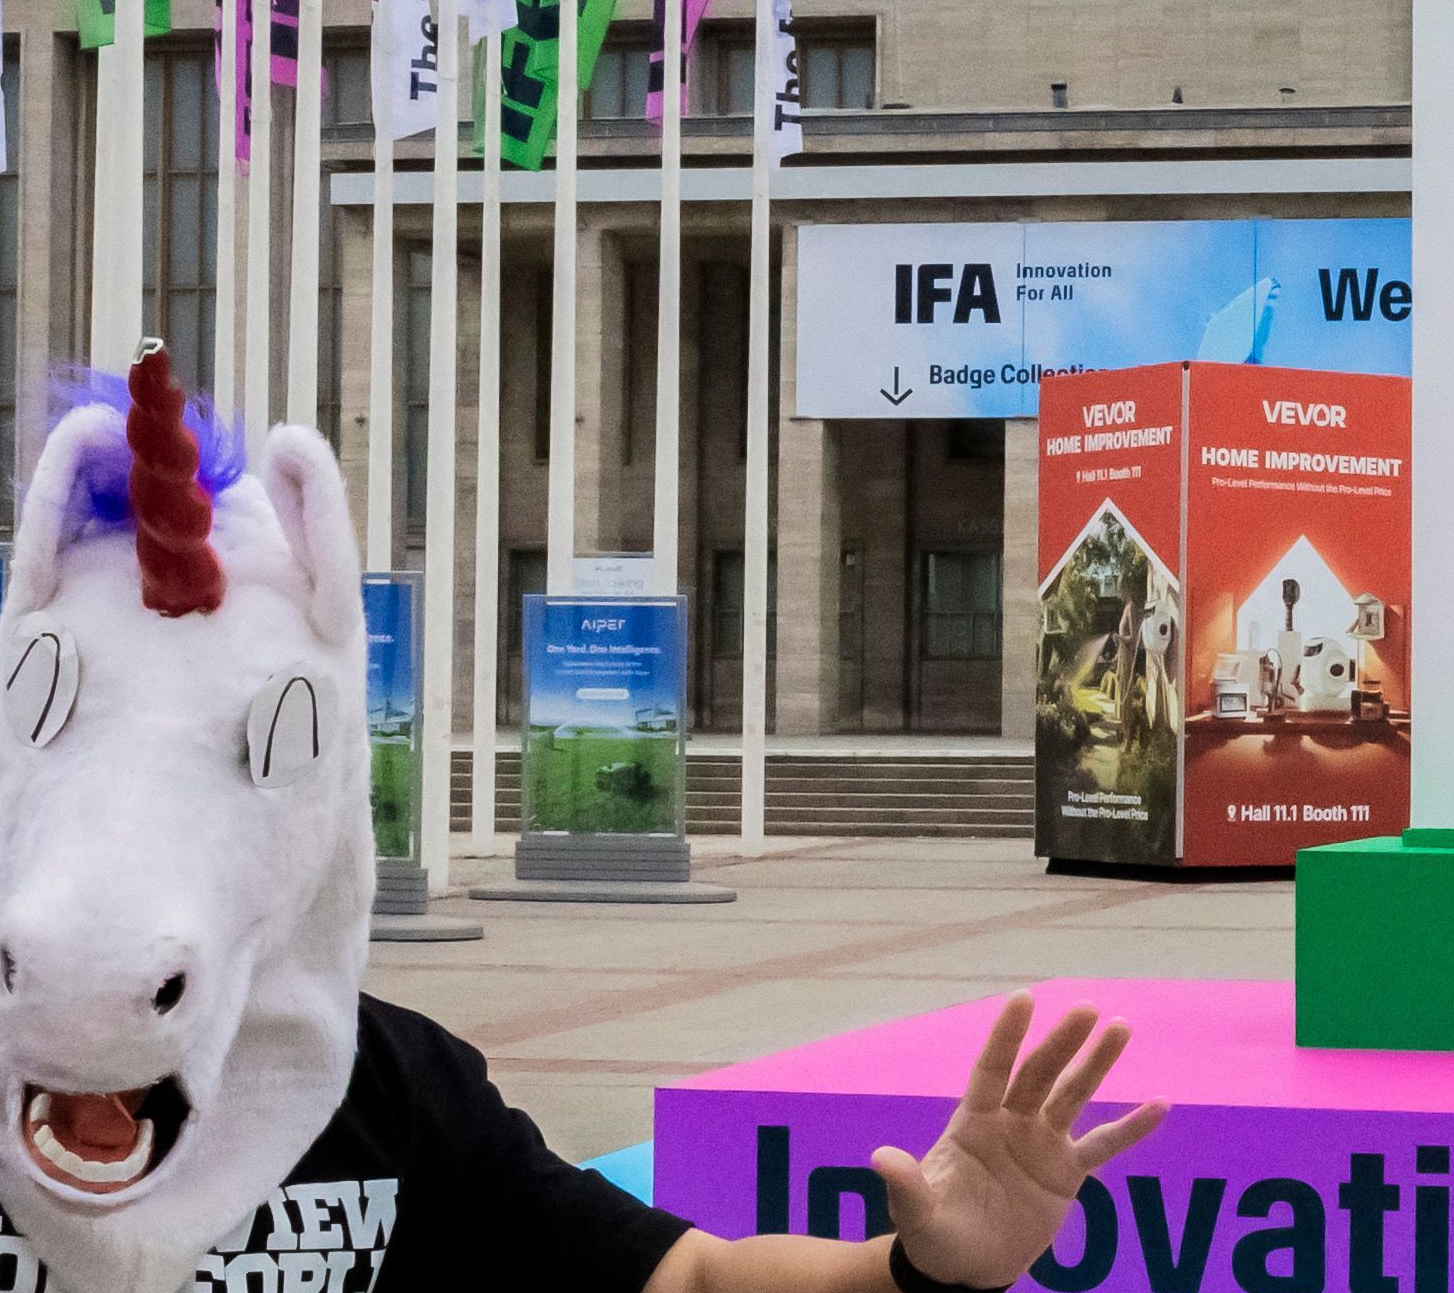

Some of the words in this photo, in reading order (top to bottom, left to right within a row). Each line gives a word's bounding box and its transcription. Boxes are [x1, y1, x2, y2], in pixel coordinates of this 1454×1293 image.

[1016, 262, 1112, 281] Innovation
[894, 263, 1002, 324] IFA
[1016, 285, 1048, 302] For
[1051, 284, 1074, 301] All
[930, 364, 995, 389] Badge
[1083, 400, 1136, 428] VEVOR
[1261, 400, 1347, 429] VEVOR
[1047, 434, 1081, 457] HOME
[1084, 425, 1173, 452] IMPROVEMENT
[1201, 446, 1259, 469] HOME
[1264, 450, 1402, 478] IMPROVEMENT
[1212, 476, 1247, 489] Pro-Level
[1249, 478, 1295, 492] Performance
[1297, 481, 1325, 493] Without
[1339, 483, 1374, 496] Pro-Level
[1241, 804, 1271, 822] Hall
[1273, 804, 1298, 822] 11.1
[1302, 804, 1348, 822] Booth
[1349, 804, 1371, 822] 111
